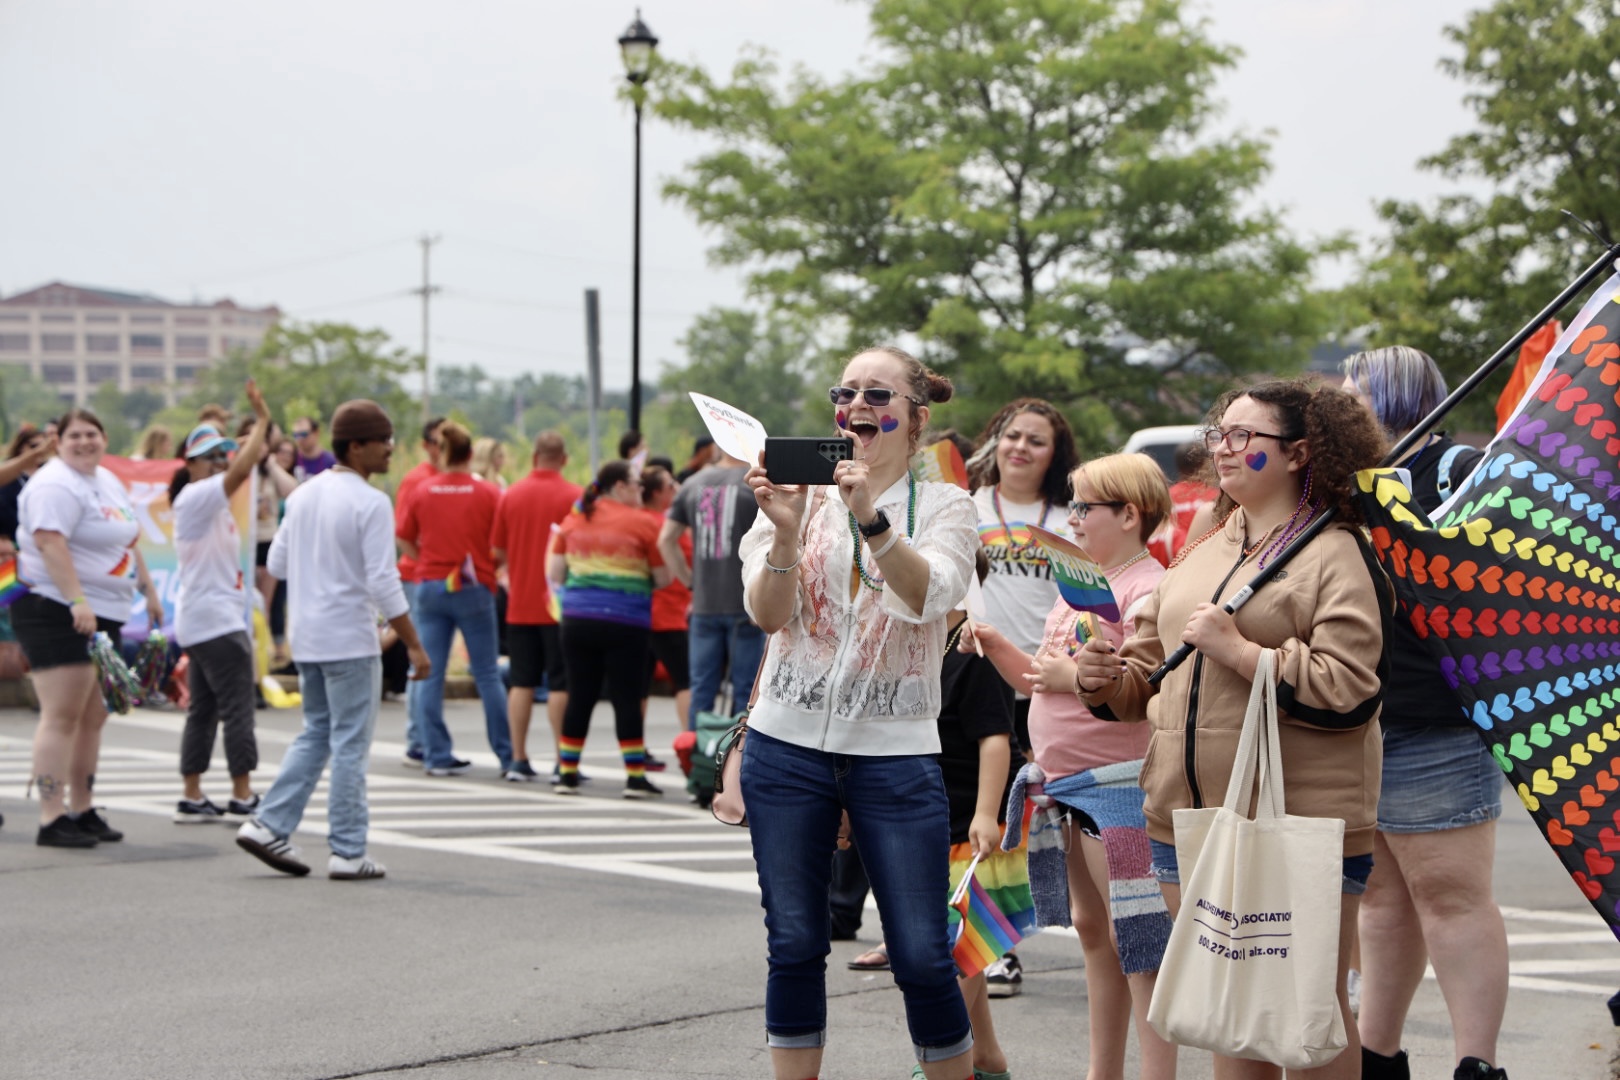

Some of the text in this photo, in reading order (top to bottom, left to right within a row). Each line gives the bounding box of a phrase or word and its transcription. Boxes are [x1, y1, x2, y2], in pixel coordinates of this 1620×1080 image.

[703, 400, 755, 429] KeyBank
[989, 559, 1057, 581] SANTI
[1044, 545, 1108, 591] PRIDE
[1196, 898, 1233, 923] ALZHEIME
